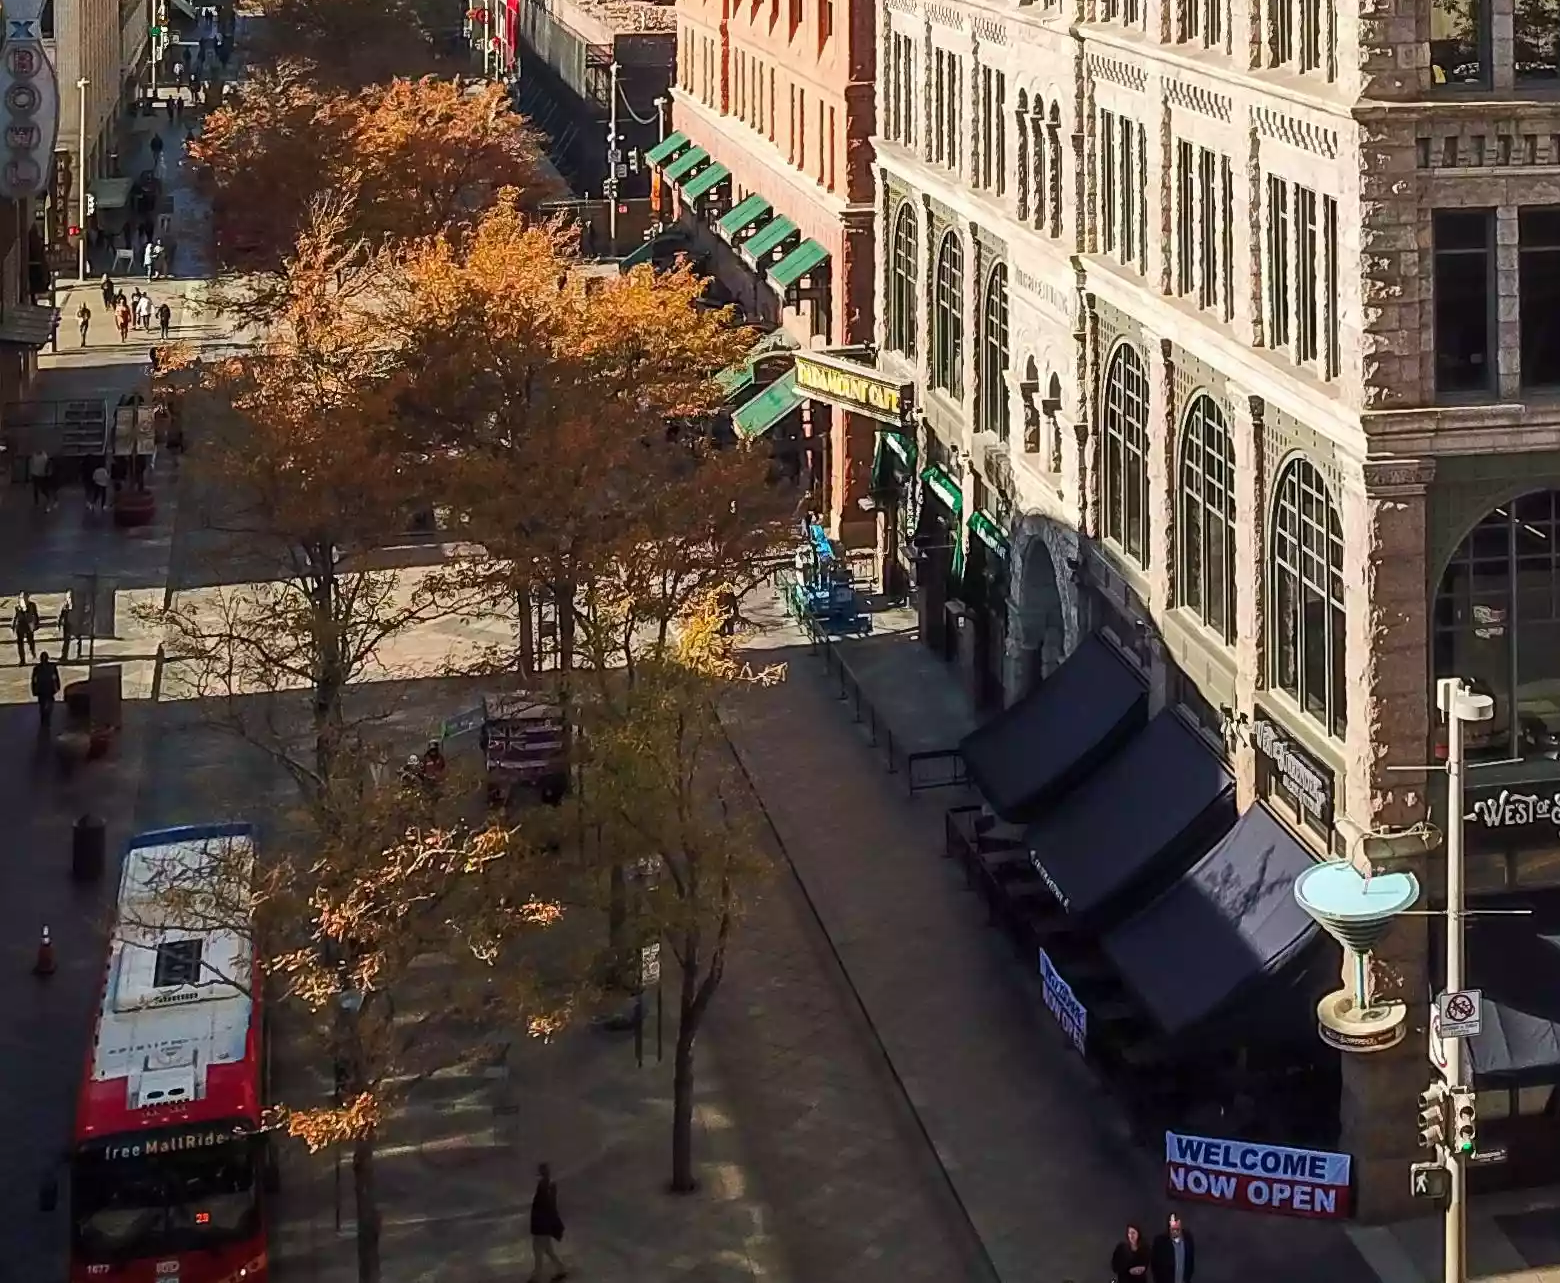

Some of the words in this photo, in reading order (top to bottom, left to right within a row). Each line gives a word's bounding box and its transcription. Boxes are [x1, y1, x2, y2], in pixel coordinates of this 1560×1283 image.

[10, 49, 36, 186] BOWL
[1176, 1137, 1328, 1180] WELCOME
[1169, 1166, 1238, 1201] NOW
[1247, 1180, 1337, 1213] OPEN
